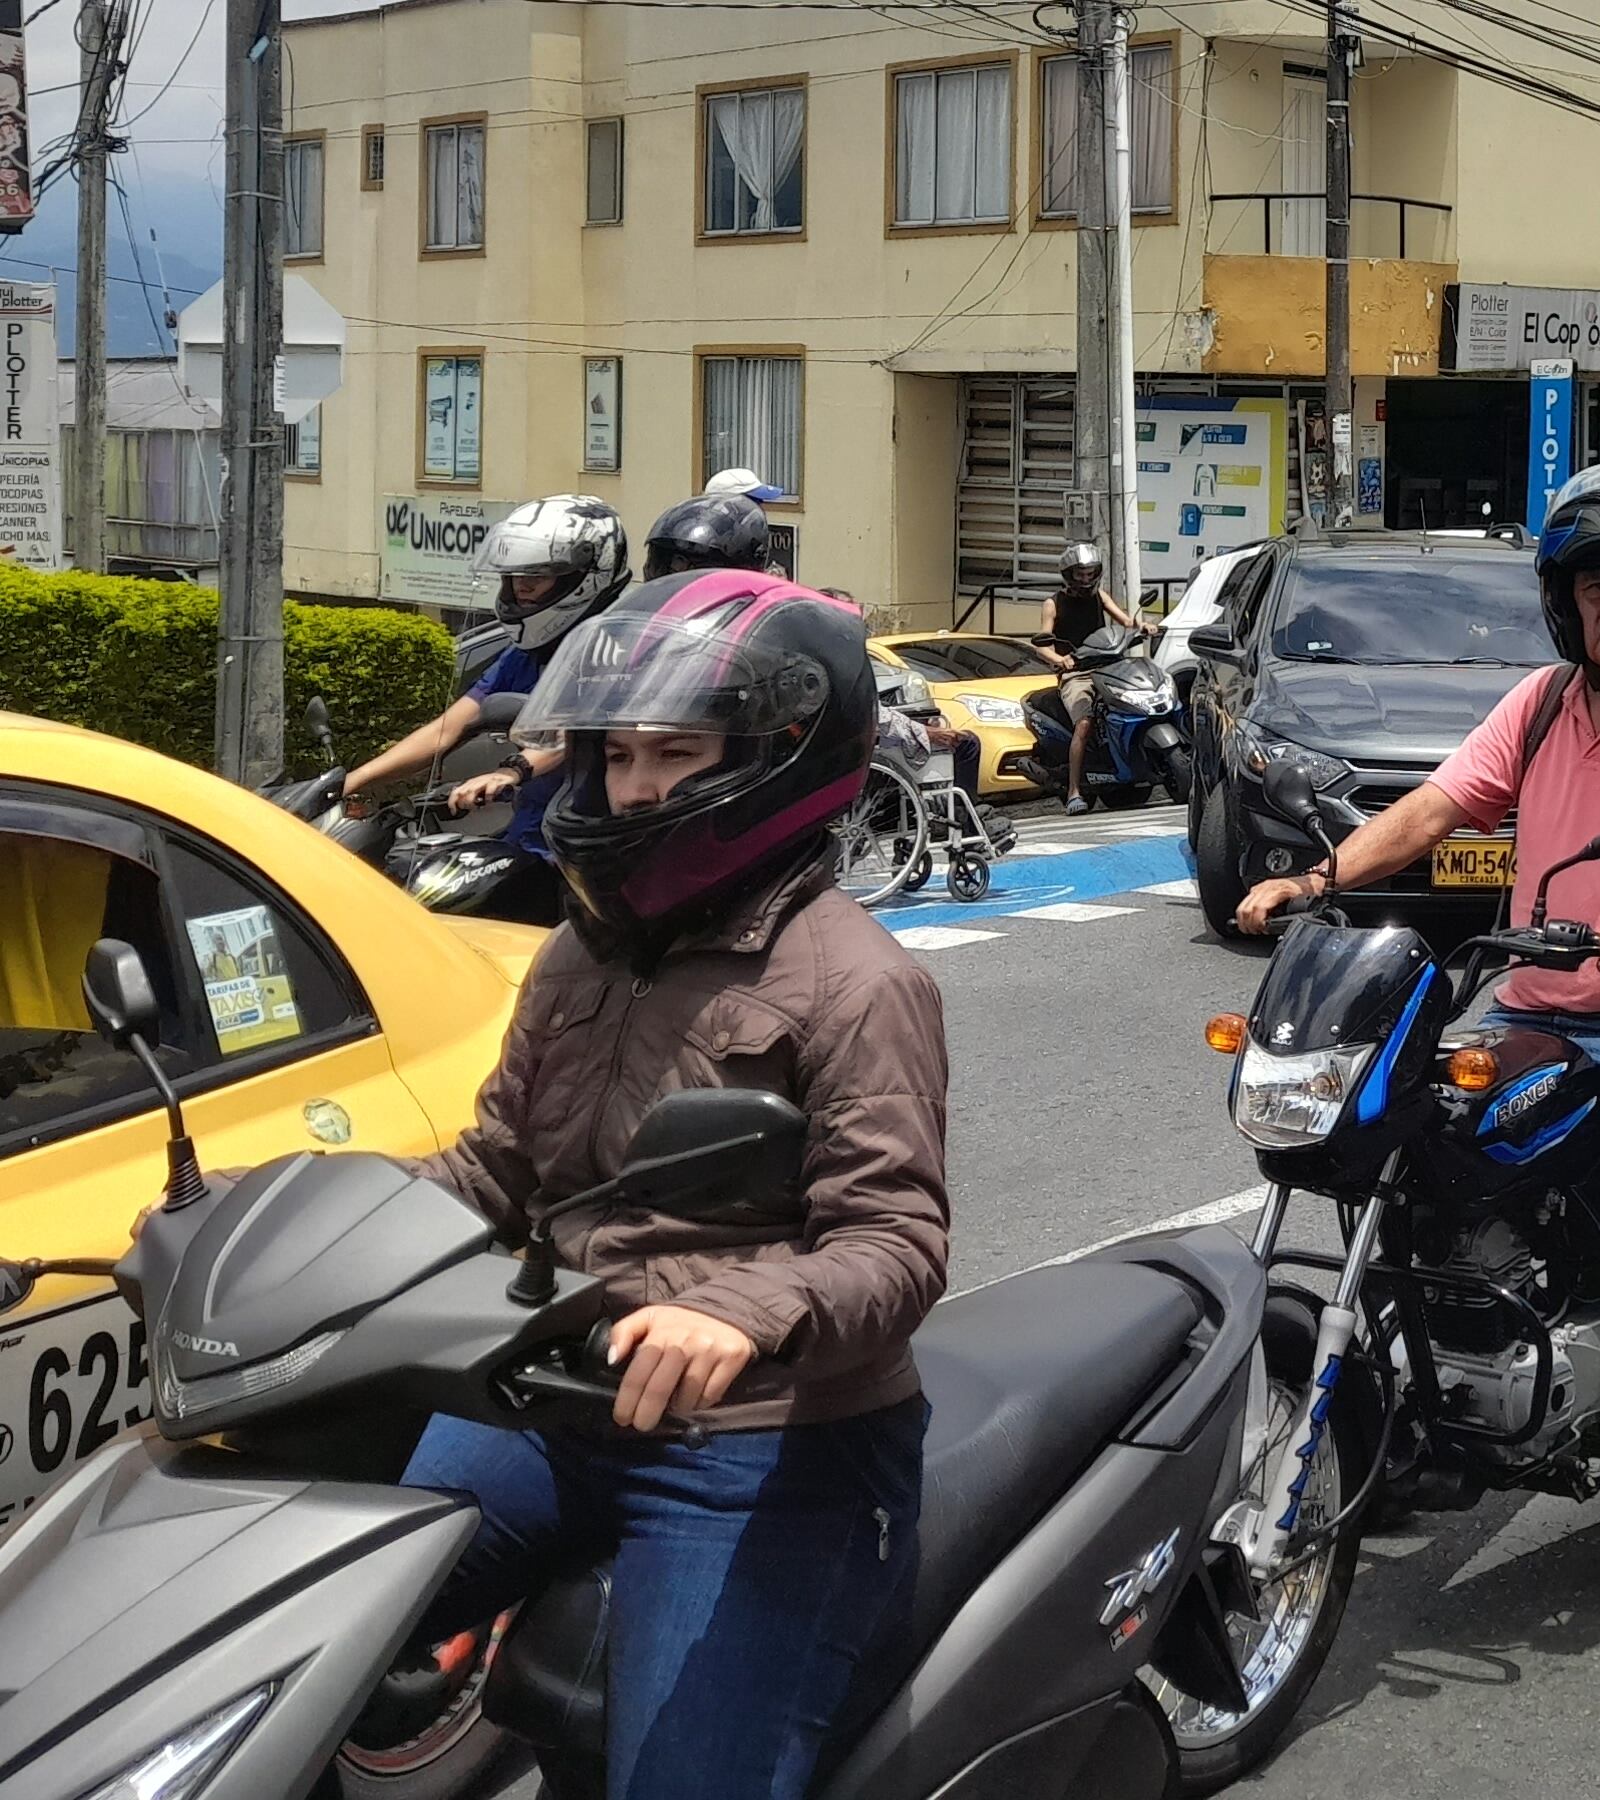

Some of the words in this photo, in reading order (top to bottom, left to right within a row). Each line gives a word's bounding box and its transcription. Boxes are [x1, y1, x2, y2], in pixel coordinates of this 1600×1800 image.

[2, 297, 43, 308] plotter
[1470, 293, 1509, 312] Plotter
[1523, 312, 1539, 343] El
[6, 322, 26, 440] PLOTTER
[411, 512, 491, 555] UNICOP
[207, 982, 239, 997] TARIFAS
[1493, 1072, 1558, 1128] BOXER
[171, 1329, 240, 1358] HONDA
